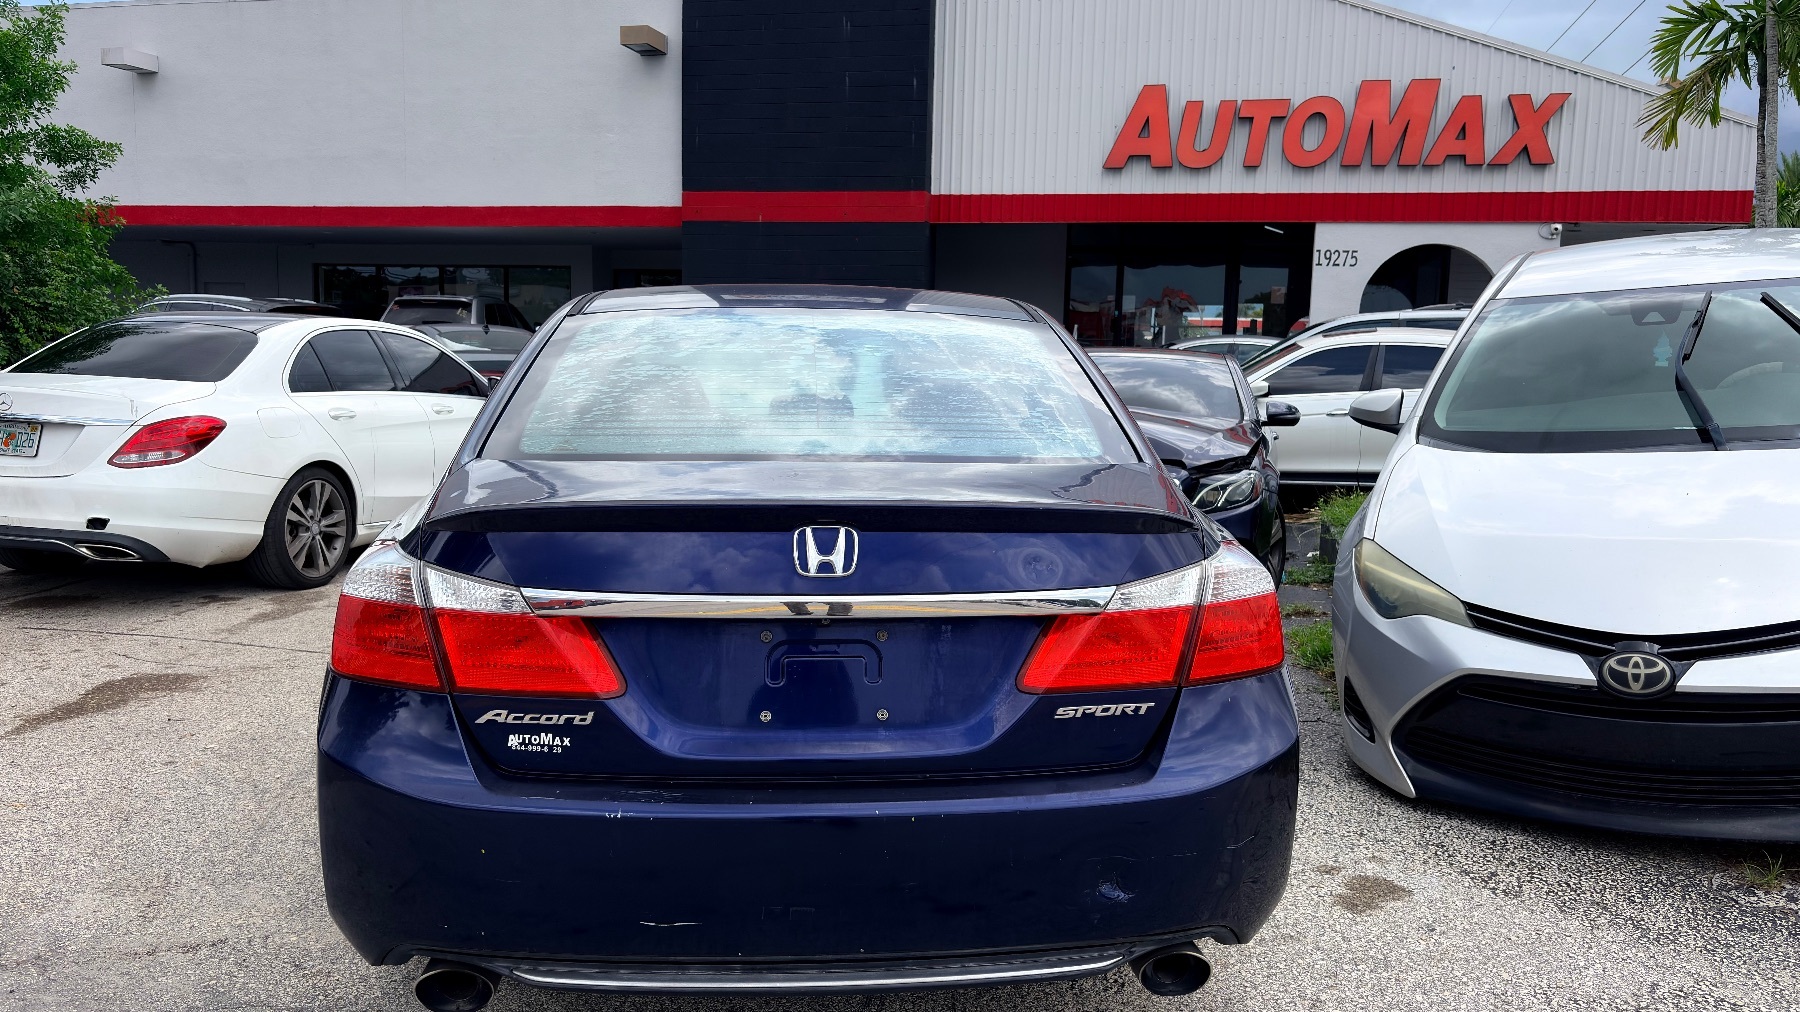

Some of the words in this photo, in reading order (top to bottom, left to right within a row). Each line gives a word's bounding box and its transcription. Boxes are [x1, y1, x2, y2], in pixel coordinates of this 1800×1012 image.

[1102, 78, 1573, 169] AUTOMAX
[1315, 249, 1358, 267] 19275
[475, 709, 595, 725] Accord
[1054, 702, 1155, 719] SPORT
